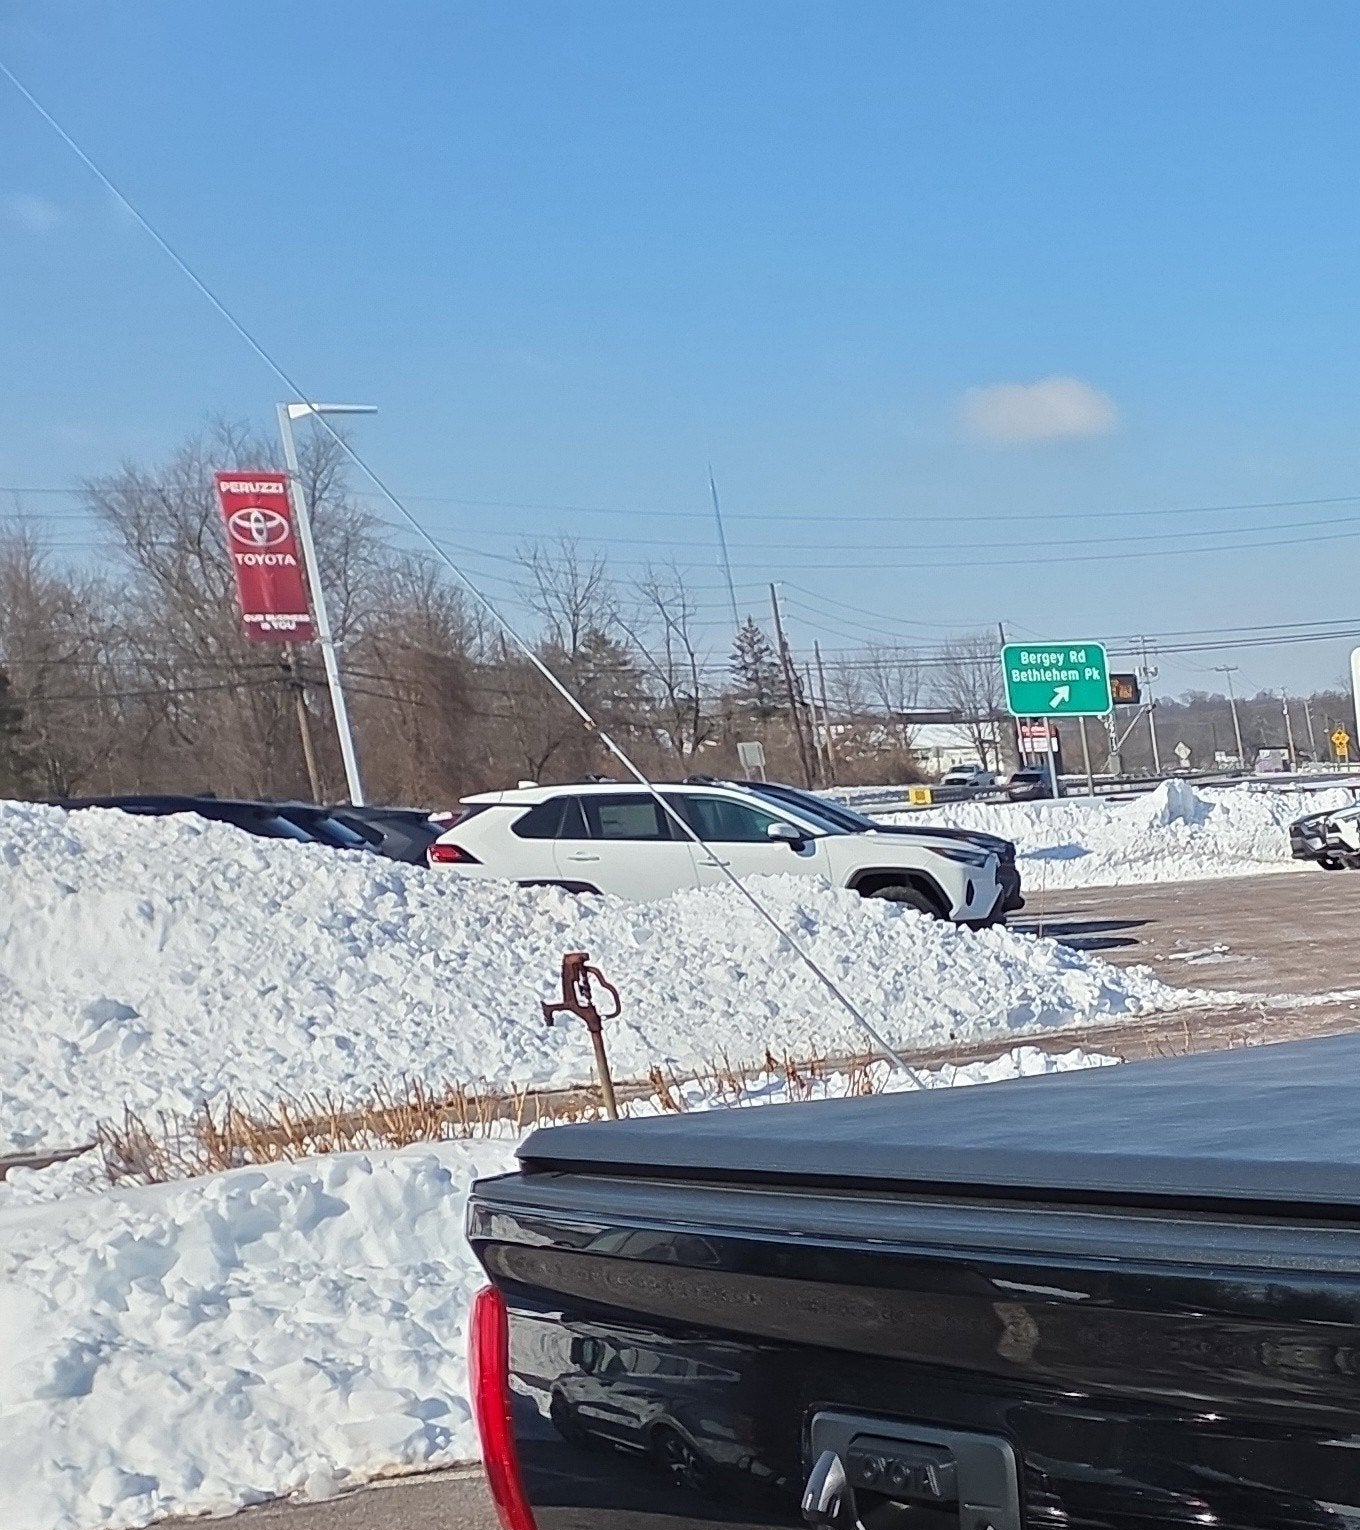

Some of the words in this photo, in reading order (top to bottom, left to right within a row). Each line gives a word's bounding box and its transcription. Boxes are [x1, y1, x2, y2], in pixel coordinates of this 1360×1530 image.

[220, 482, 284, 494] PERUZZI
[235, 553, 297, 566] TOYOTA
[271, 621, 297, 631] YOU
[1020, 651, 1065, 667] Bergey
[1069, 650, 1087, 664] Rd
[1011, 667, 1080, 683] Bethlehem
[1084, 667, 1101, 681] Pk
